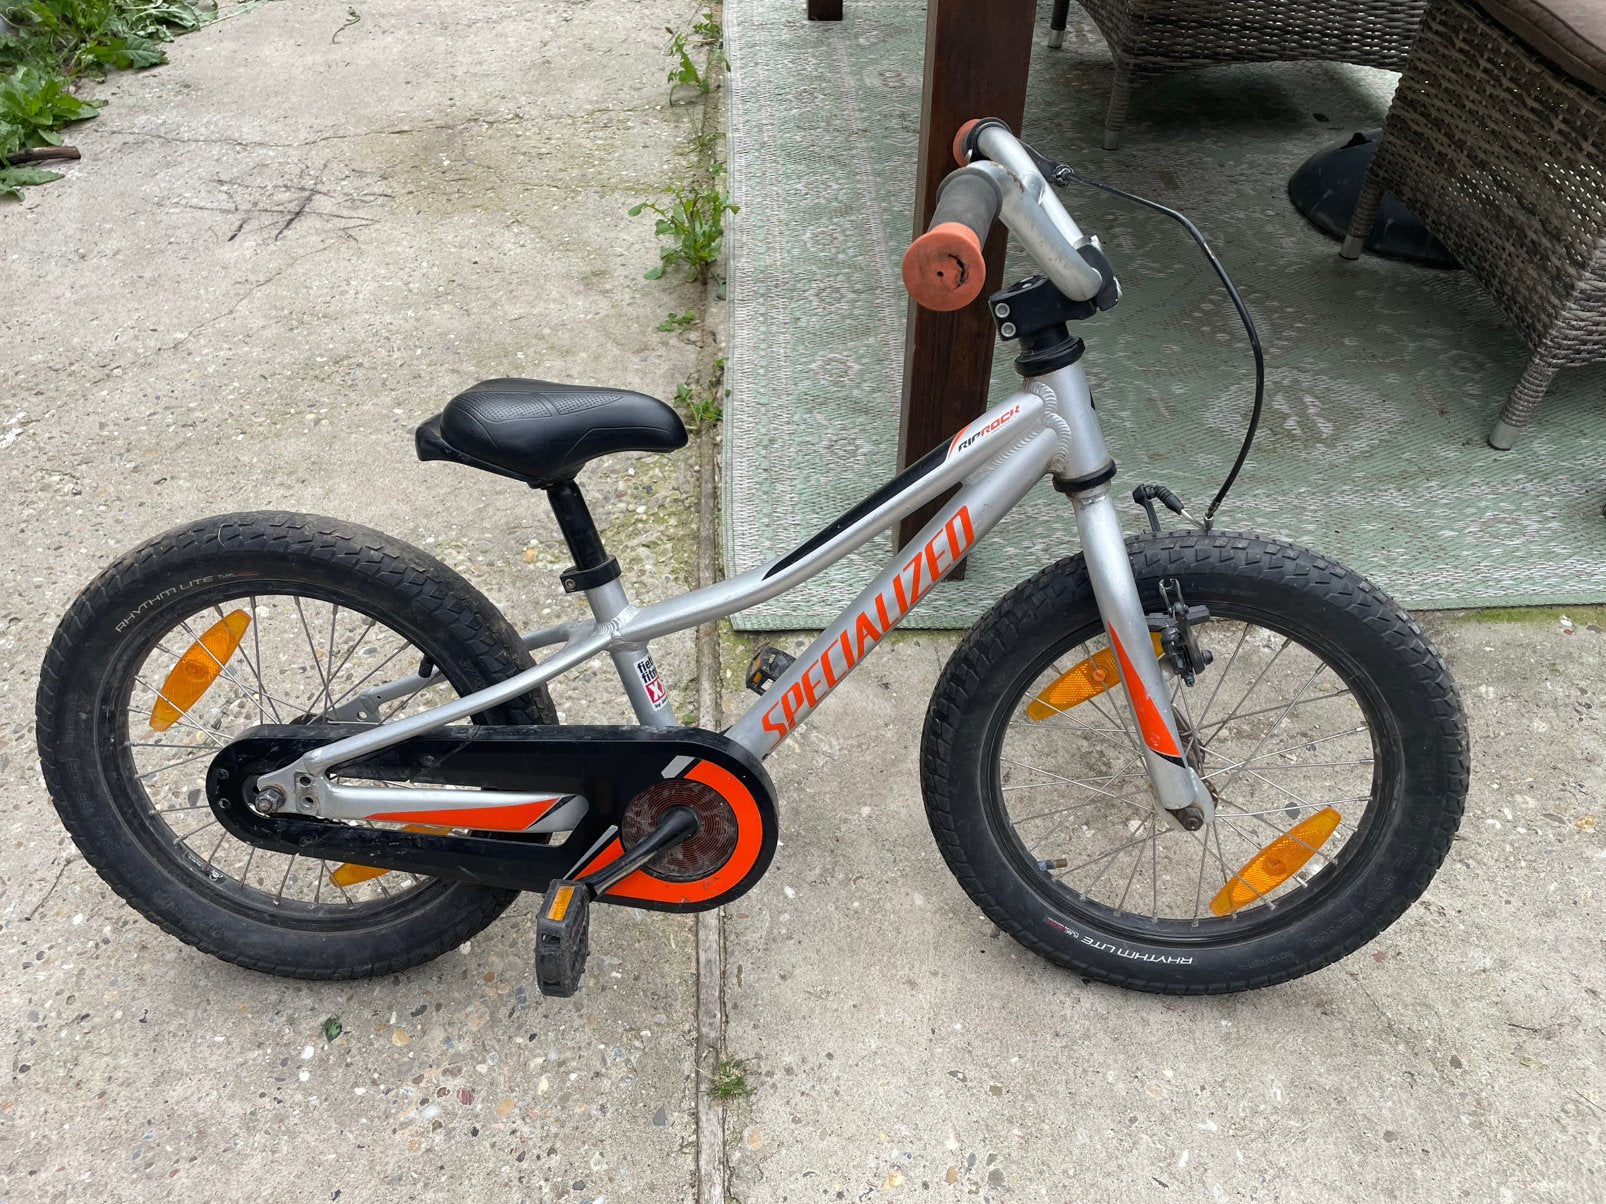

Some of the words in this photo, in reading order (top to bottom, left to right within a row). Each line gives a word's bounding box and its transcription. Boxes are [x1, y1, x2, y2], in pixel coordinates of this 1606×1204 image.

[958, 404, 1020, 452] RIPROCK
[115, 587, 177, 633] RHYTHM
[179, 575, 214, 590] LITE
[761, 505, 975, 750] SPECIALIZED
[1080, 935, 1116, 956] LITE
[1117, 948, 1194, 965] RHYTHM
